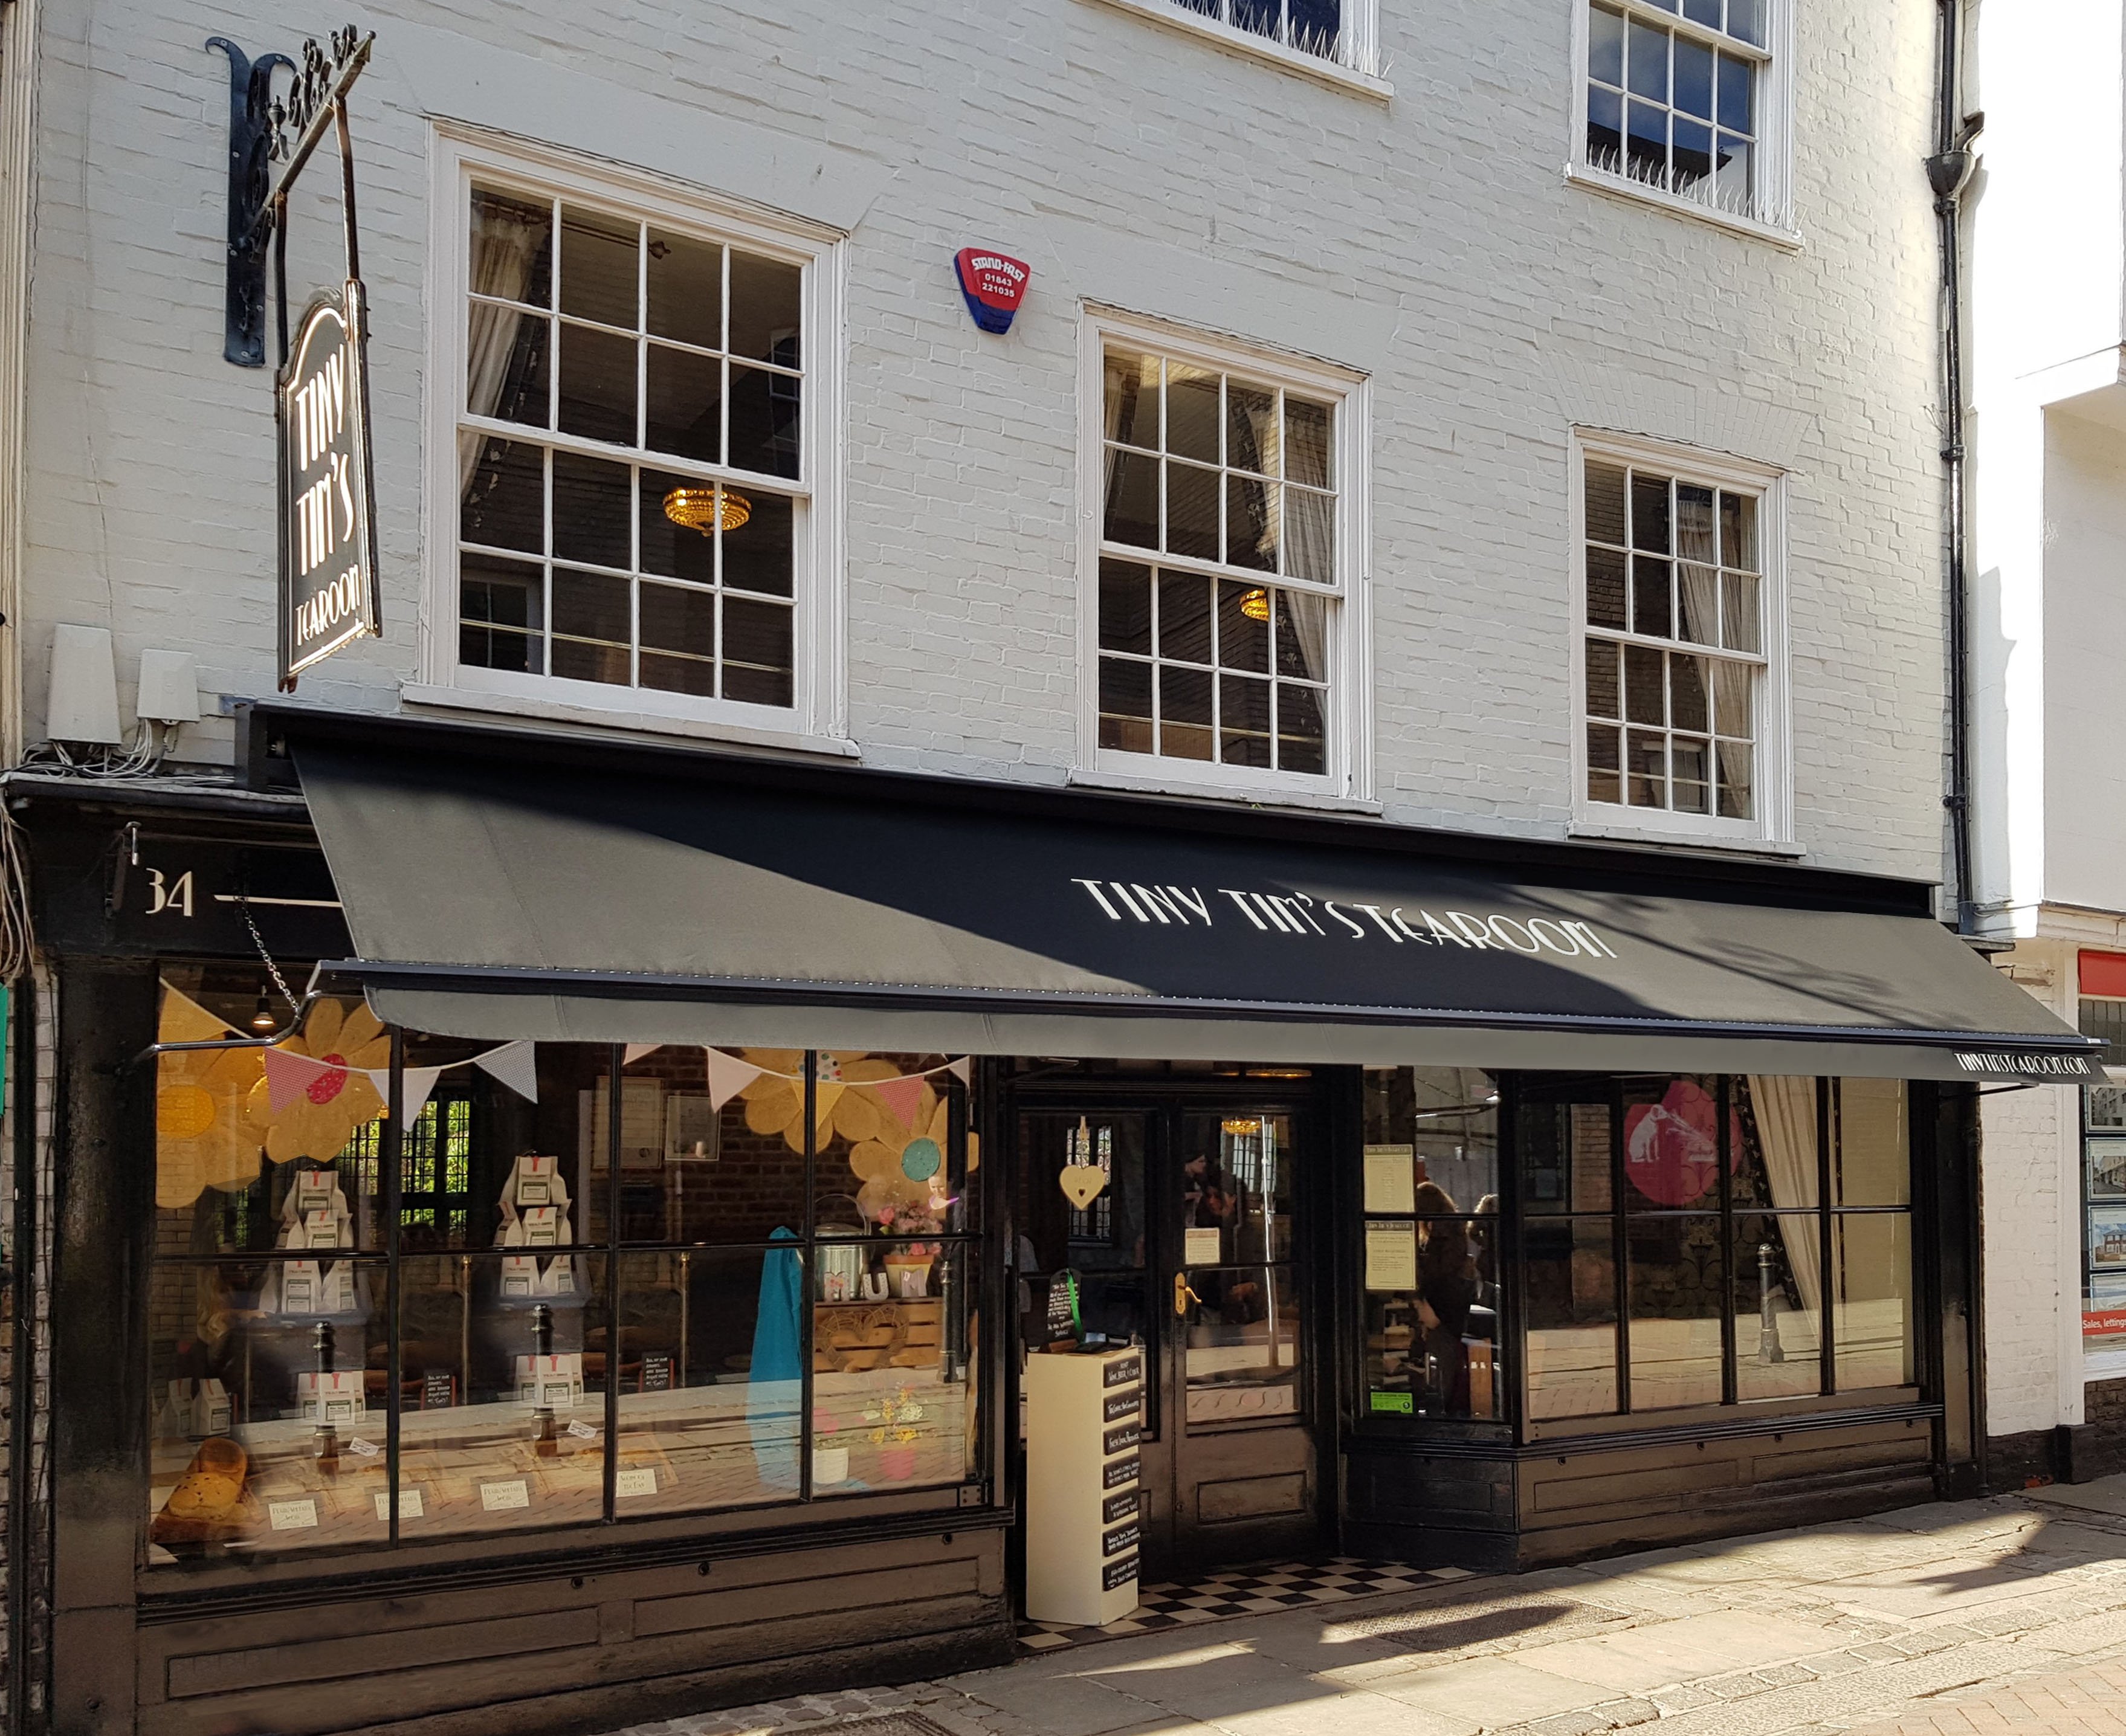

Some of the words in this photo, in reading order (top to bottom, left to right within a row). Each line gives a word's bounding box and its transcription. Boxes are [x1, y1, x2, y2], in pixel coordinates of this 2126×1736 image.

[971, 257, 1026, 283] STAND-FAST
[982, 282, 1015, 298] 221035
[984, 273, 1012, 286] 01843
[295, 343, 344, 471] TINY
[296, 451, 354, 576] TIM'S
[296, 564, 361, 647] TEAROOM
[145, 867, 192, 917] 34
[1070, 877, 1212, 926] TINY
[1217, 888, 1365, 939] TIM'S
[1352, 903, 1618, 959] TEAROOM
[2082, 1319, 2102, 1329] Sales,
